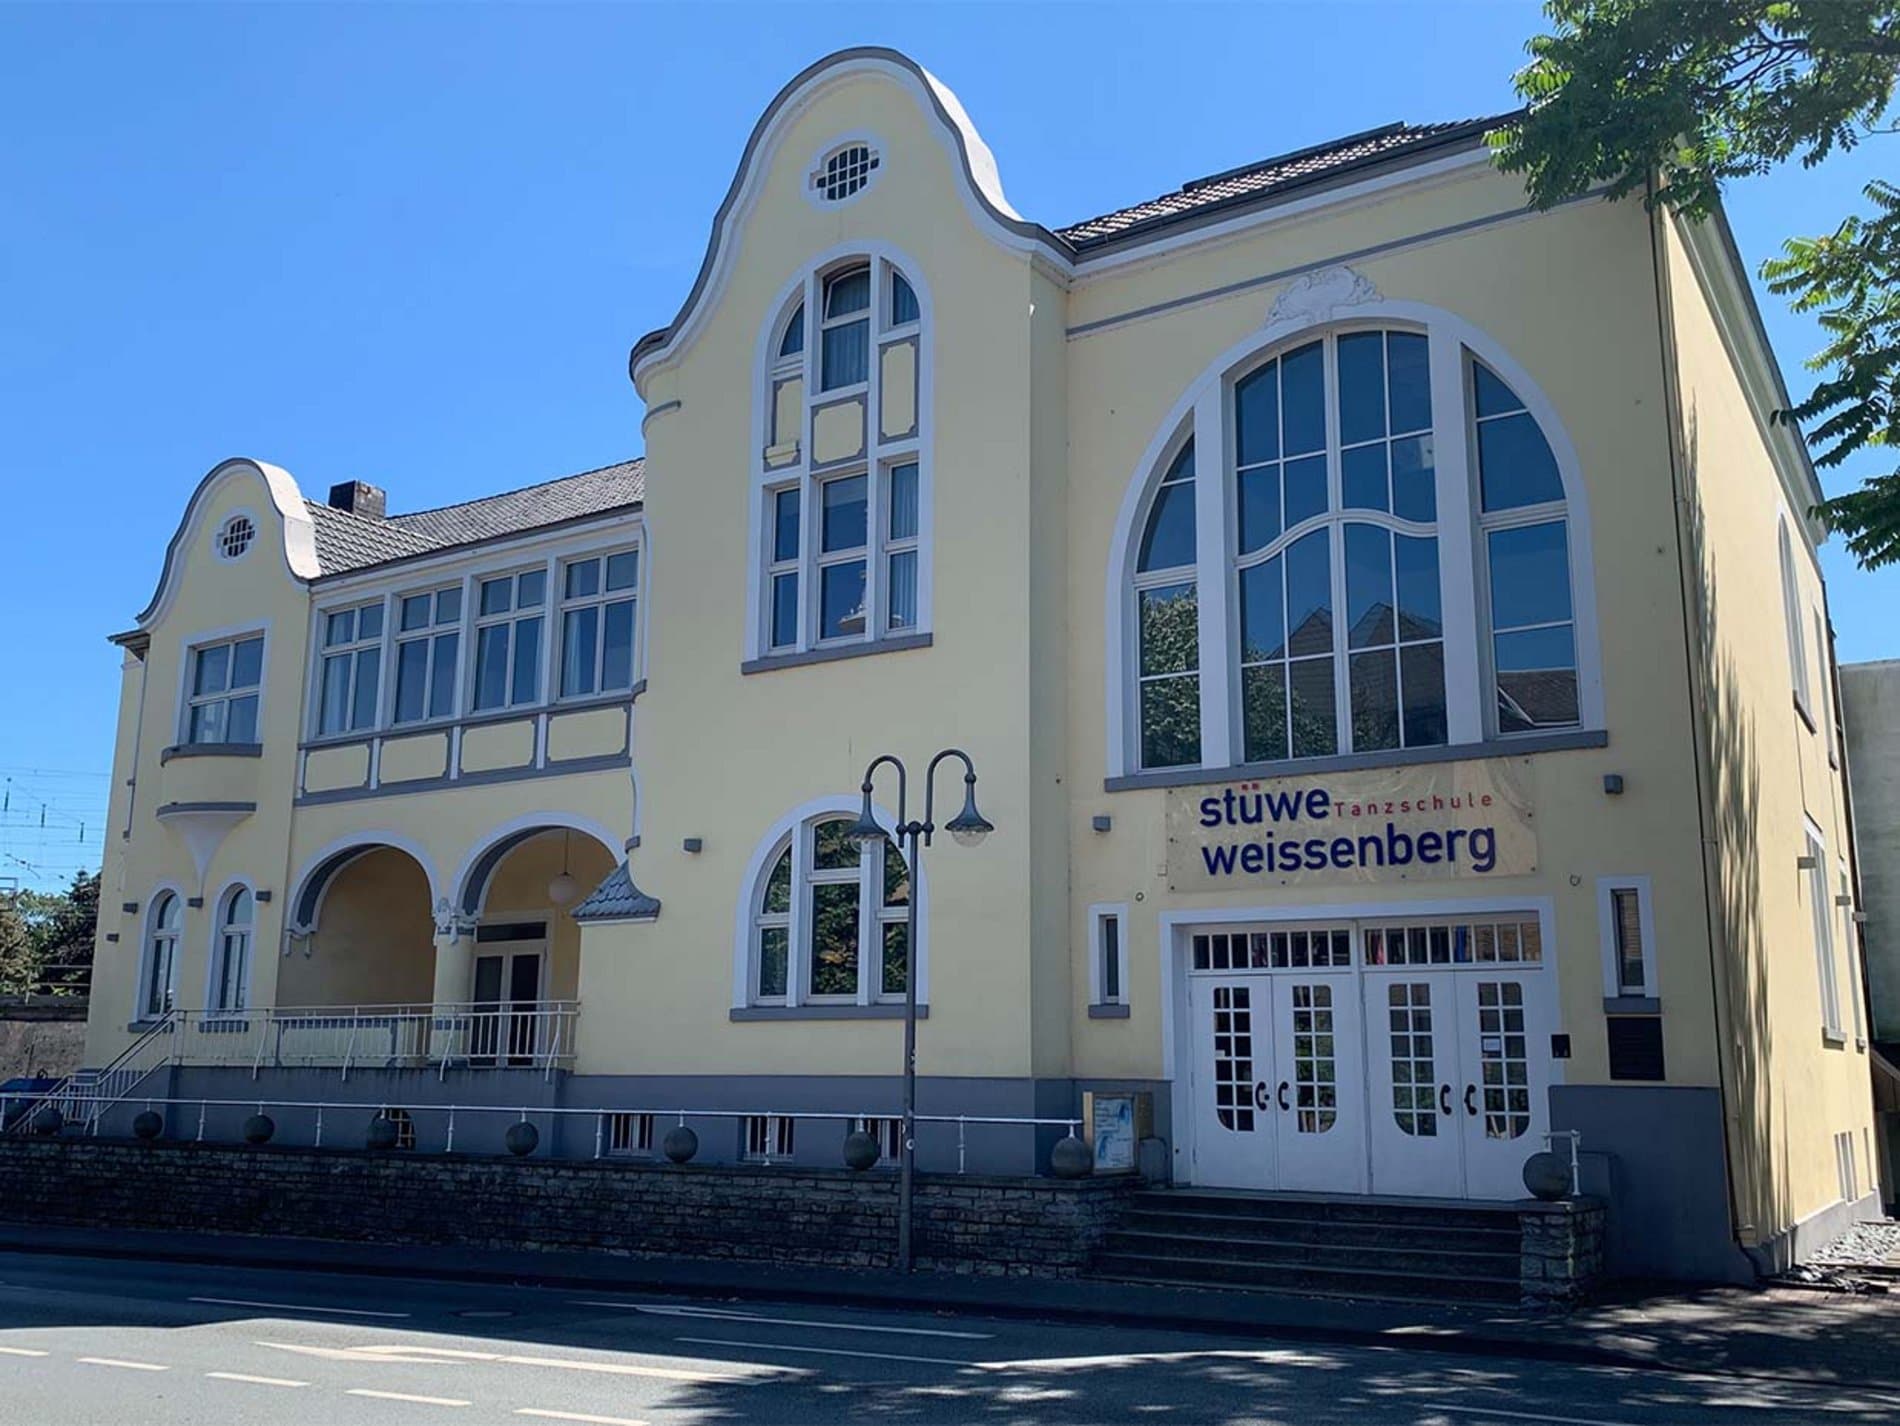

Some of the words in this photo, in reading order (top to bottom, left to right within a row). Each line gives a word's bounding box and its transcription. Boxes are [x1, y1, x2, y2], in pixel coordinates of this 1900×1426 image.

[1200, 783, 1330, 827] stüwe
[1334, 792, 1493, 817] Tanzschule
[1201, 823, 1496, 876] weissenberg
